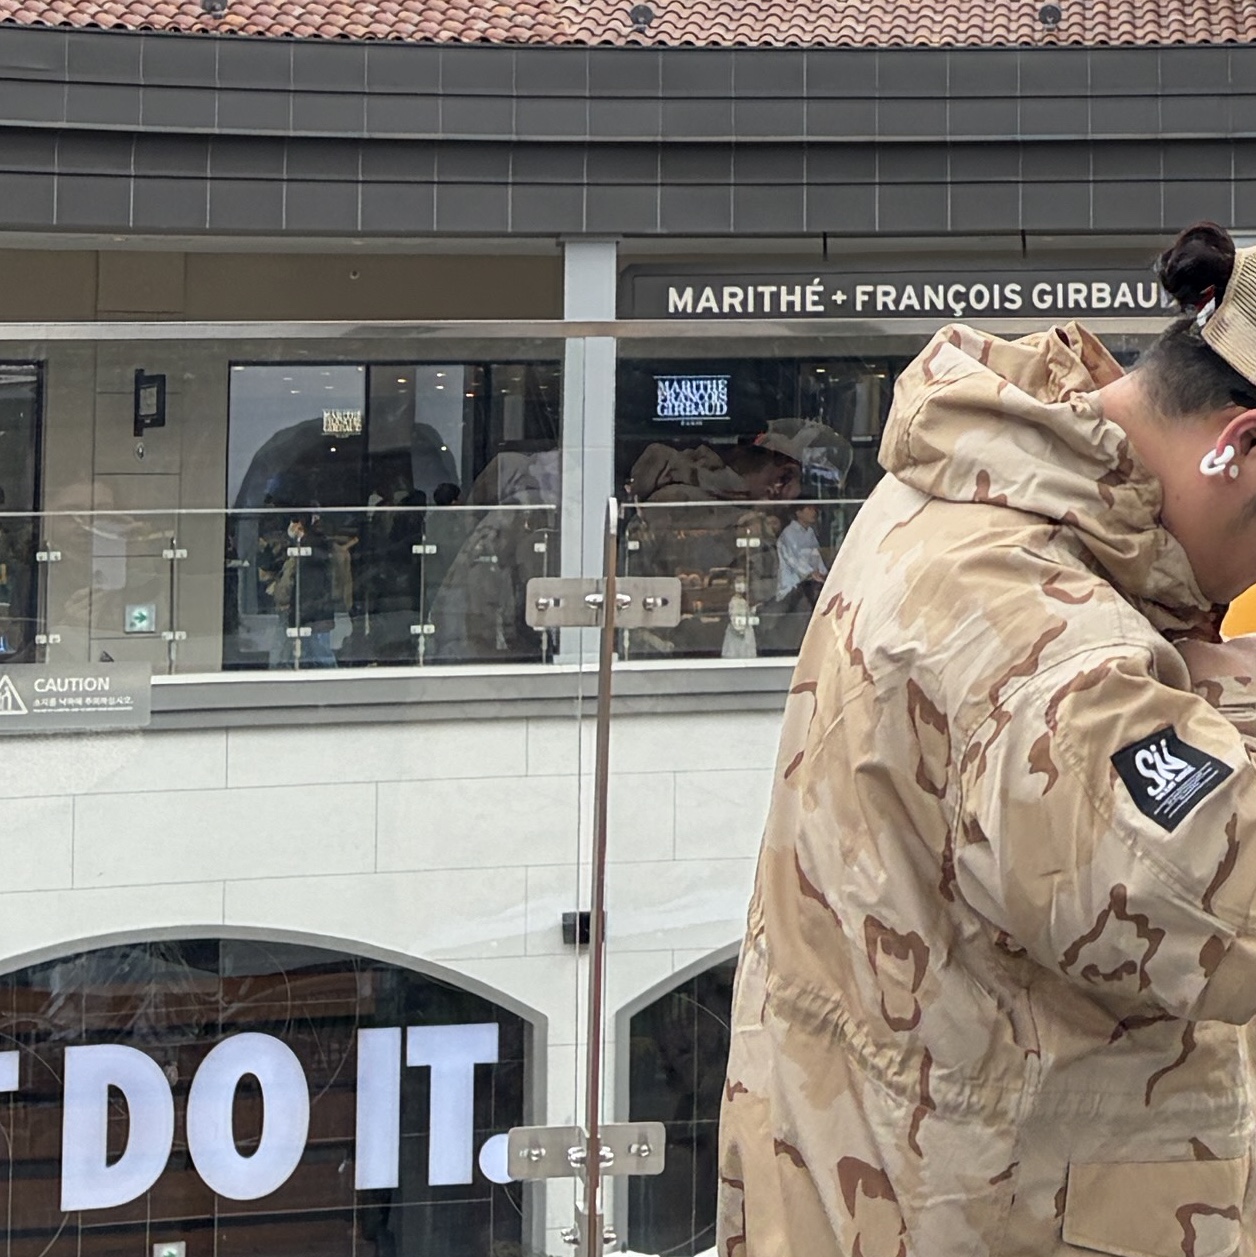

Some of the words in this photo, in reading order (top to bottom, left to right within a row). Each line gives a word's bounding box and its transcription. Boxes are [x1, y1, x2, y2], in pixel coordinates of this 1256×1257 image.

[668, 277, 825, 314] MARITHÉ
[855, 282, 1023, 316] FRANÇOIS
[1031, 282, 1177, 310] GIRBAU
[656, 400, 728, 416] GIRBAUD
[33, 677, 110, 692] CAUTION
[60, 1031, 311, 1212] DO
[354, 1022, 509, 1191] IT.
